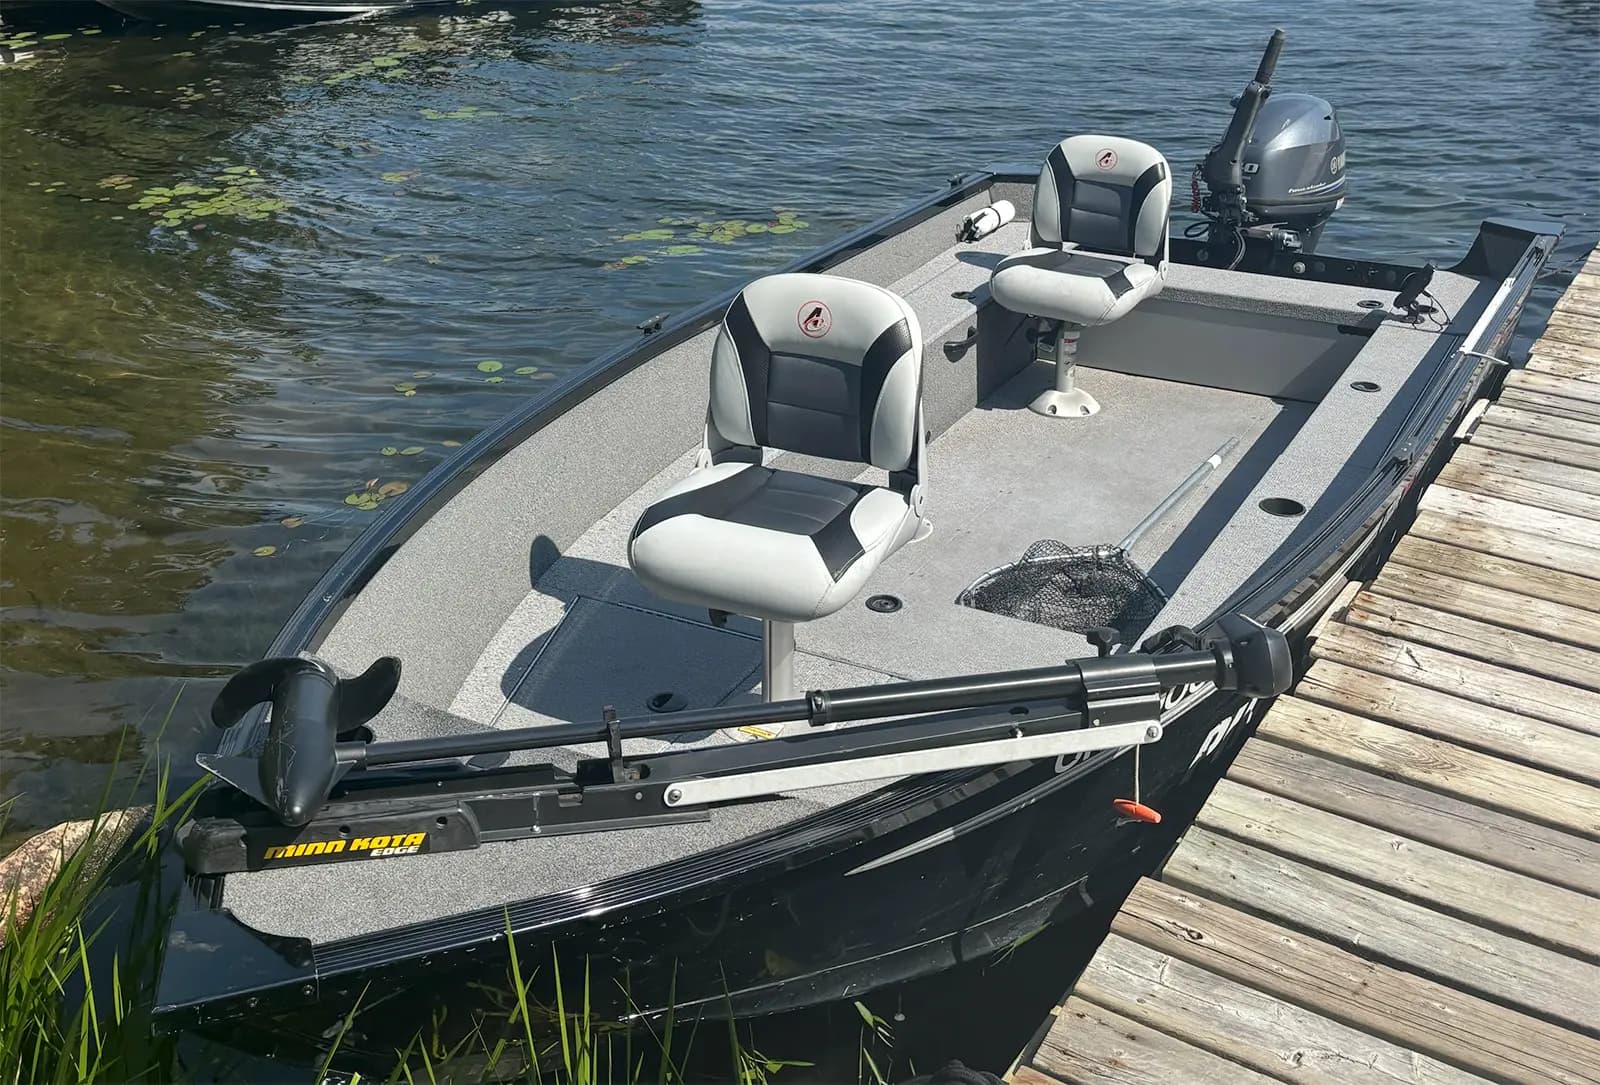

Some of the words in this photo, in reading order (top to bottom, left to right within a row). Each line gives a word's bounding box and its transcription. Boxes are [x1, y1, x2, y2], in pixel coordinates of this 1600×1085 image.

[264, 840, 346, 859] MINN
[349, 832, 427, 851] KOTA
[370, 845, 420, 857] EDGE
